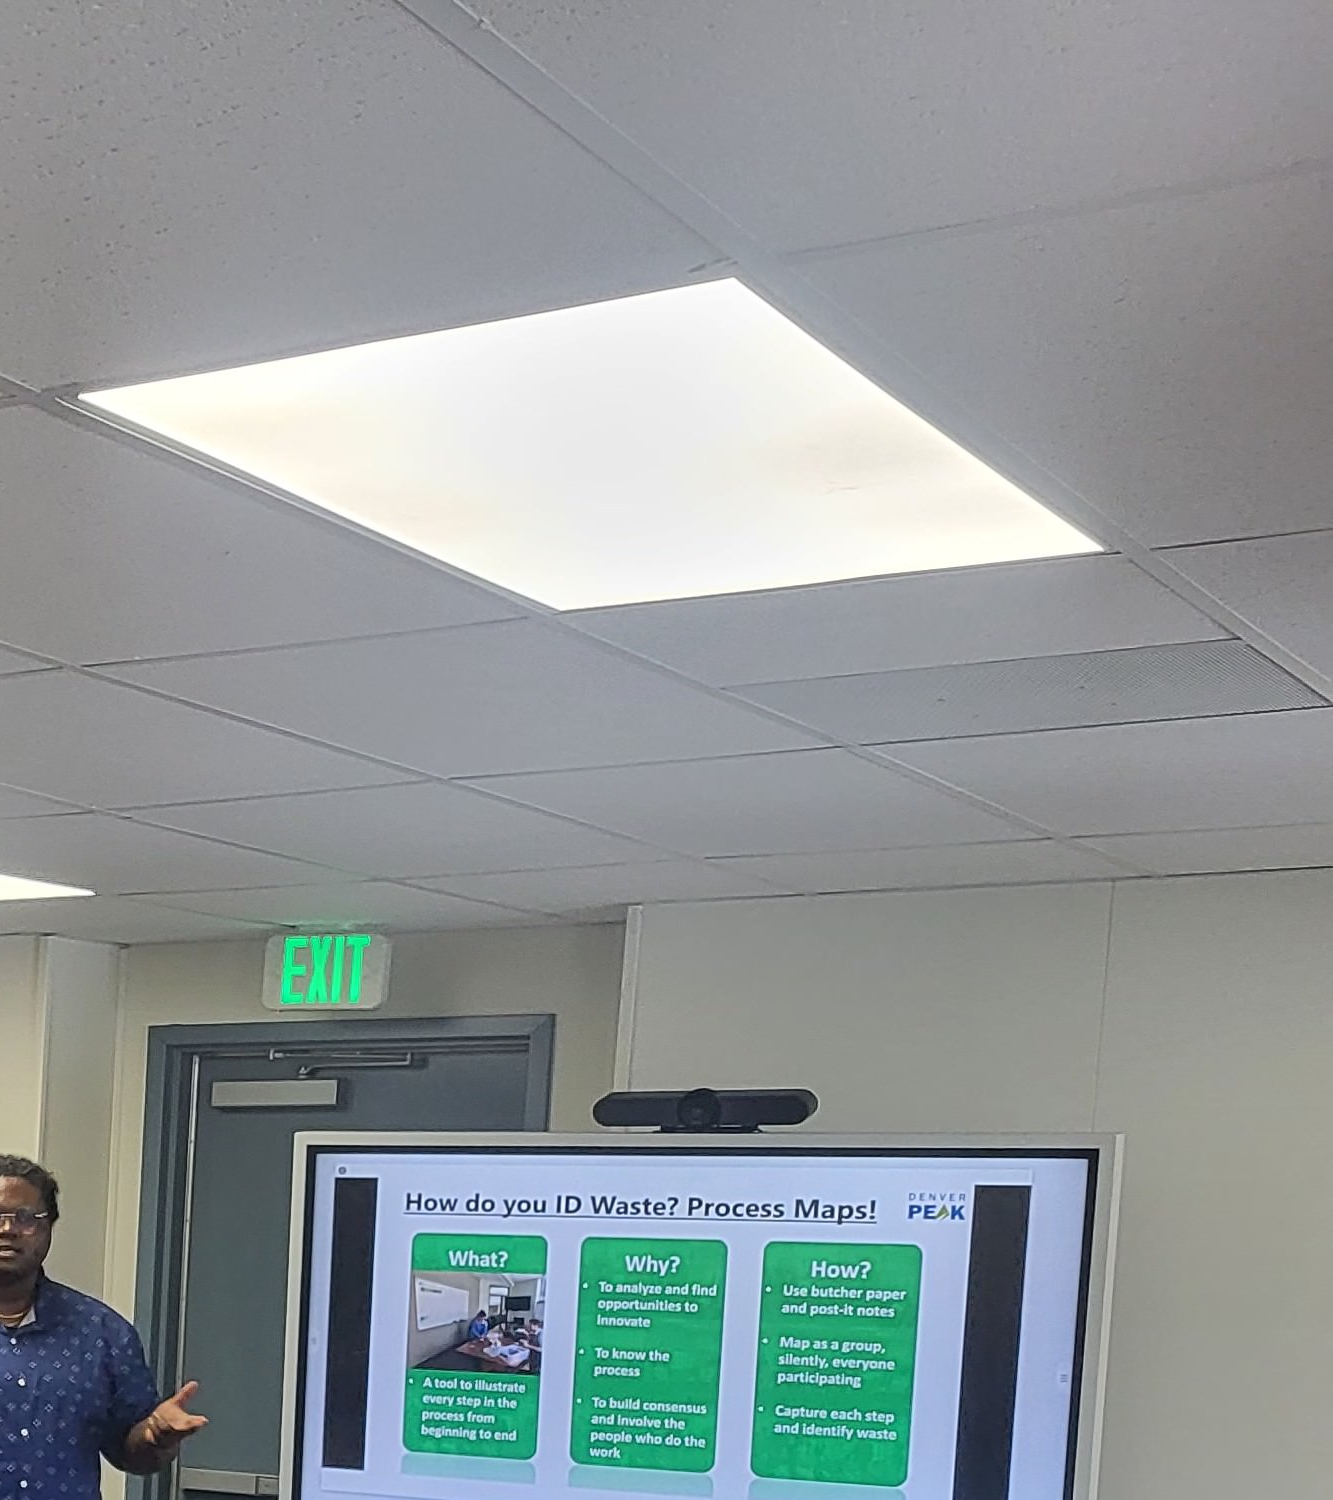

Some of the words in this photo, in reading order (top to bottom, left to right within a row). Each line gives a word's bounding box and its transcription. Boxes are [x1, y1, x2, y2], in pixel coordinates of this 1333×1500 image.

[280, 933, 372, 1005] EXIT
[908, 1192, 966, 1202] DENVER
[405, 1193, 457, 1212] How
[465, 1193, 495, 1213] do
[503, 1198, 546, 1218] you
[556, 1195, 582, 1214] ID
[590, 1196, 679, 1216] Waste?
[688, 1197, 784, 1218] Process
[794, 1199, 877, 1224] Maps!
[907, 1204, 966, 1221] PEAK
[448, 1250, 509, 1268] What?
[625, 1254, 681, 1277] Why?
[810, 1260, 872, 1279] How?
[598, 1281, 614, 1293] To
[615, 1282, 662, 1296] analyze
[664, 1283, 689, 1295] and
[691, 1284, 718, 1297] find
[783, 1284, 808, 1297] Use
[810, 1285, 863, 1299] butcher
[865, 1289, 907, 1302] paper
[597, 1299, 682, 1312] opportunities
[684, 1301, 698, 1313] to
[781, 1302, 806, 1314] and
[809, 1303, 854, 1317] post-it
[856, 1306, 895, 1318] notes
[779, 1336, 810, 1351] Map
[812, 1339, 828, 1350] as
[830, 1340, 839, 1350] a
[841, 1341, 886, 1354] group,
[594, 1347, 609, 1359] To
[612, 1349, 646, 1361] know
[649, 1350, 670, 1362] the
[778, 1353, 829, 1369] silently,
[832, 1358, 896, 1372] everyone
[593, 1365, 641, 1377] process
[777, 1371, 862, 1389] participating
[422, 1377, 433, 1388] A
[434, 1378, 458, 1390] tool
[460, 1379, 472, 1390] to
[475, 1379, 526, 1394] illustrate
[422, 1394, 454, 1407] every
[455, 1395, 481, 1408] step
[484, 1396, 495, 1408] in
[497, 1396, 517, 1409] the
[591, 1396, 607, 1408] To
[609, 1397, 641, 1411] build
[642, 1402, 707, 1415] consensus
[421, 1410, 464, 1422] process
[467, 1411, 495, 1424] from
[590, 1414, 614, 1426] and
[617, 1414, 662, 1428] involve
[664, 1417, 686, 1430] the
[775, 1404, 827, 1419] Capture
[830, 1408, 862, 1422] each
[864, 1411, 895, 1425] step
[421, 1423, 477, 1441] beginning
[479, 1429, 492, 1440] to
[494, 1430, 517, 1441] end
[590, 1430, 632, 1443] people
[635, 1433, 663, 1445] who
[665, 1434, 682, 1447] do
[684, 1436, 706, 1449] the
[773, 1422, 799, 1435] and
[802, 1423, 854, 1441] identify
[856, 1428, 897, 1441] waste
[589, 1447, 621, 1459] work
